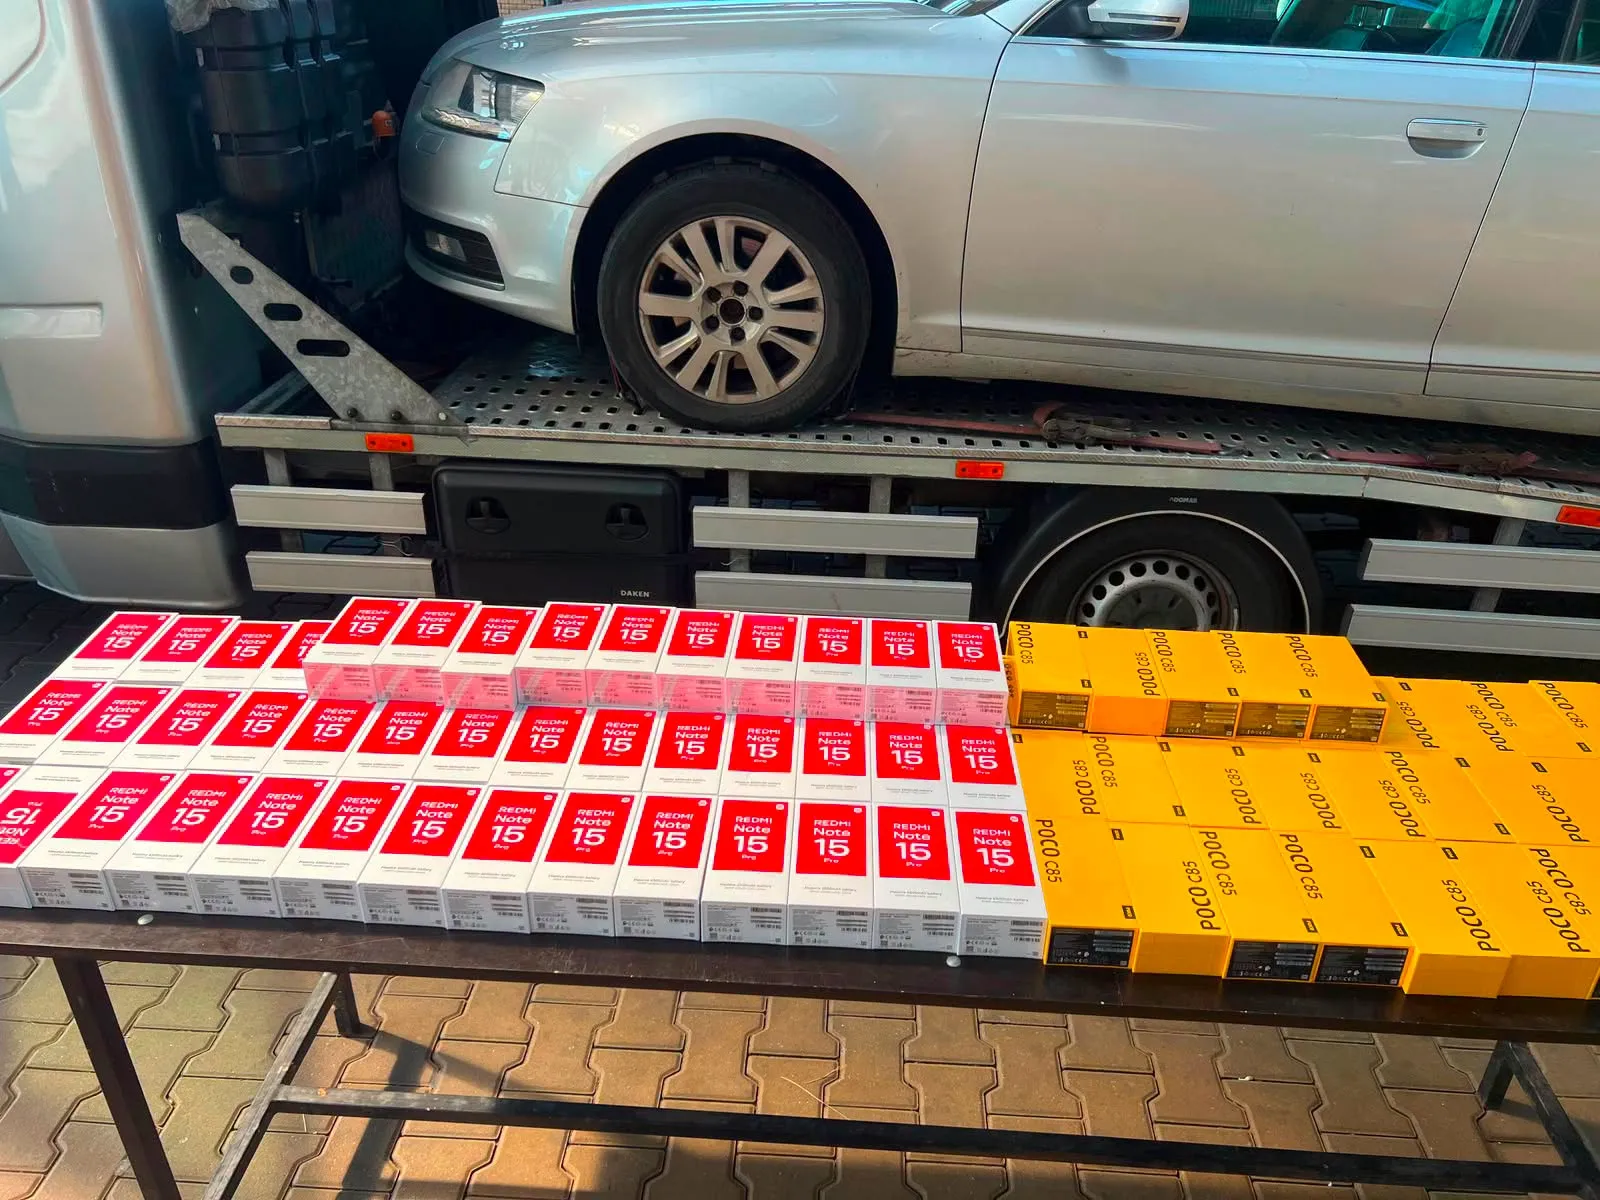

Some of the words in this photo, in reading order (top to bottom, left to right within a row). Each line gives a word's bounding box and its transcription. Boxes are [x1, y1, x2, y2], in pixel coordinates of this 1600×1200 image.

[348, 621, 379, 634] 15
[417, 623, 447, 635] 15
[552, 625, 581, 639] 15
[619, 628, 649, 641] 15
[1016, 623, 1034, 648] POCO
[103, 635, 136, 649] 15
[481, 630, 511, 643] 15
[686, 633, 715, 645] 15
[751, 637, 781, 649] 15
[1151, 631, 1173, 656] POCO
[168, 639, 200, 651] 15
[231, 645, 261, 658] 15
[819, 639, 848, 653] 15
[885, 643, 915, 656] 15
[953, 645, 984, 659] 15
[1217, 632, 1242, 658] POCO
[1230, 659, 1246, 673] C85
[1020, 650, 1034, 664] C85
[1134, 651, 1151, 667] C85
[1285, 635, 1312, 661] POCO
[1299, 663, 1319, 679] C85
[1160, 657, 1177, 674] C85
[1137, 668, 1160, 696] POCO
[38, 698, 73, 706] Note
[104, 705, 140, 713] Note
[1397, 700, 1416, 717] C85
[1470, 683, 1505, 710] POCO
[1496, 711, 1517, 727] C85
[1538, 682, 1574, 710] POCO
[1566, 712, 1588, 728] C85
[28, 707, 65, 721] 15
[175, 708, 211, 717] Note
[248, 710, 282, 718] Note
[317, 714, 353, 723] Note
[1466, 705, 1487, 720] C85
[95, 713, 132, 729] 15
[168, 717, 204, 732] 15
[241, 718, 276, 733] 15
[389, 717, 423, 725] Note
[461, 719, 495, 728] Note
[531, 725, 565, 733] Note
[313, 723, 346, 738] 15
[385, 725, 417, 741] 15
[458, 728, 490, 743] 15
[603, 728, 637, 736] Note
[746, 734, 780, 742] Note
[1406, 719, 1440, 749] POCO
[1477, 722, 1514, 752] POCO
[529, 733, 560, 749] 15
[601, 737, 633, 752] 15
[674, 739, 705, 755] 15
[961, 745, 997, 753] Note
[747, 743, 778, 759] 15
[819, 746, 851, 761] 15
[891, 749, 924, 765] 15
[1090, 736, 1114, 767] POCO
[964, 754, 998, 770] 15
[1073, 760, 1089, 778] C85
[1101, 770, 1118, 787] C85
[1225, 769, 1243, 786] C85
[1300, 772, 1320, 791] C85
[1385, 751, 1419, 783] POCO
[1409, 785, 1431, 804] C85
[187, 789, 227, 797] REDMI
[265, 792, 303, 801] REDMI
[1075, 780, 1100, 815] POCO
[1378, 780, 1400, 799] C85
[1532, 785, 1556, 803] C85
[100, 794, 139, 804] Note
[180, 797, 219, 807] Note
[257, 800, 297, 810] Note
[343, 796, 382, 804] REDMI
[1231, 789, 1262, 824] POCO
[0, 808, 42, 825] 15
[89, 805, 130, 823] 15
[171, 807, 210, 826] 15
[337, 804, 376, 814] Note
[415, 809, 453, 819] Note
[497, 806, 536, 814] REDMI
[577, 809, 615, 817] REDMI
[655, 811, 694, 820] REDMI
[1308, 793, 1342, 829] POCO
[251, 811, 289, 829] 15
[332, 815, 369, 833] 15
[494, 813, 532, 824] Note
[573, 817, 612, 827] Note
[653, 819, 691, 830] Note
[735, 815, 773, 824] REDMI
[893, 822, 931, 831] REDMI
[1389, 801, 1426, 837] POCO
[1547, 805, 1590, 842] POCO
[411, 819, 447, 838] 15
[491, 825, 526, 843] 15
[571, 827, 607, 846] 15
[733, 823, 771, 834] Note
[813, 827, 851, 837] Note
[893, 831, 931, 841] Note
[972, 828, 1011, 837] REDMI
[652, 831, 687, 849] 15
[733, 835, 769, 853] 15
[973, 836, 1012, 846] Note
[1035, 819, 1060, 857] POCO
[813, 837, 850, 857] 15
[895, 841, 932, 861] 15
[976, 847, 1014, 867] 15
[1199, 831, 1230, 869] POCO
[1216, 873, 1237, 895] C85
[1044, 860, 1062, 882] C85
[1182, 861, 1202, 883] C85
[1279, 834, 1313, 873] POCO
[1300, 876, 1324, 900] C85
[1529, 848, 1574, 889] POCO
[1563, 892, 1592, 915] C85
[1441, 879, 1467, 902] C85
[1526, 881, 1553, 904] C85
[1188, 886, 1221, 930] POCO
[1455, 906, 1500, 952] POCO
[1543, 907, 1591, 953] POCO
